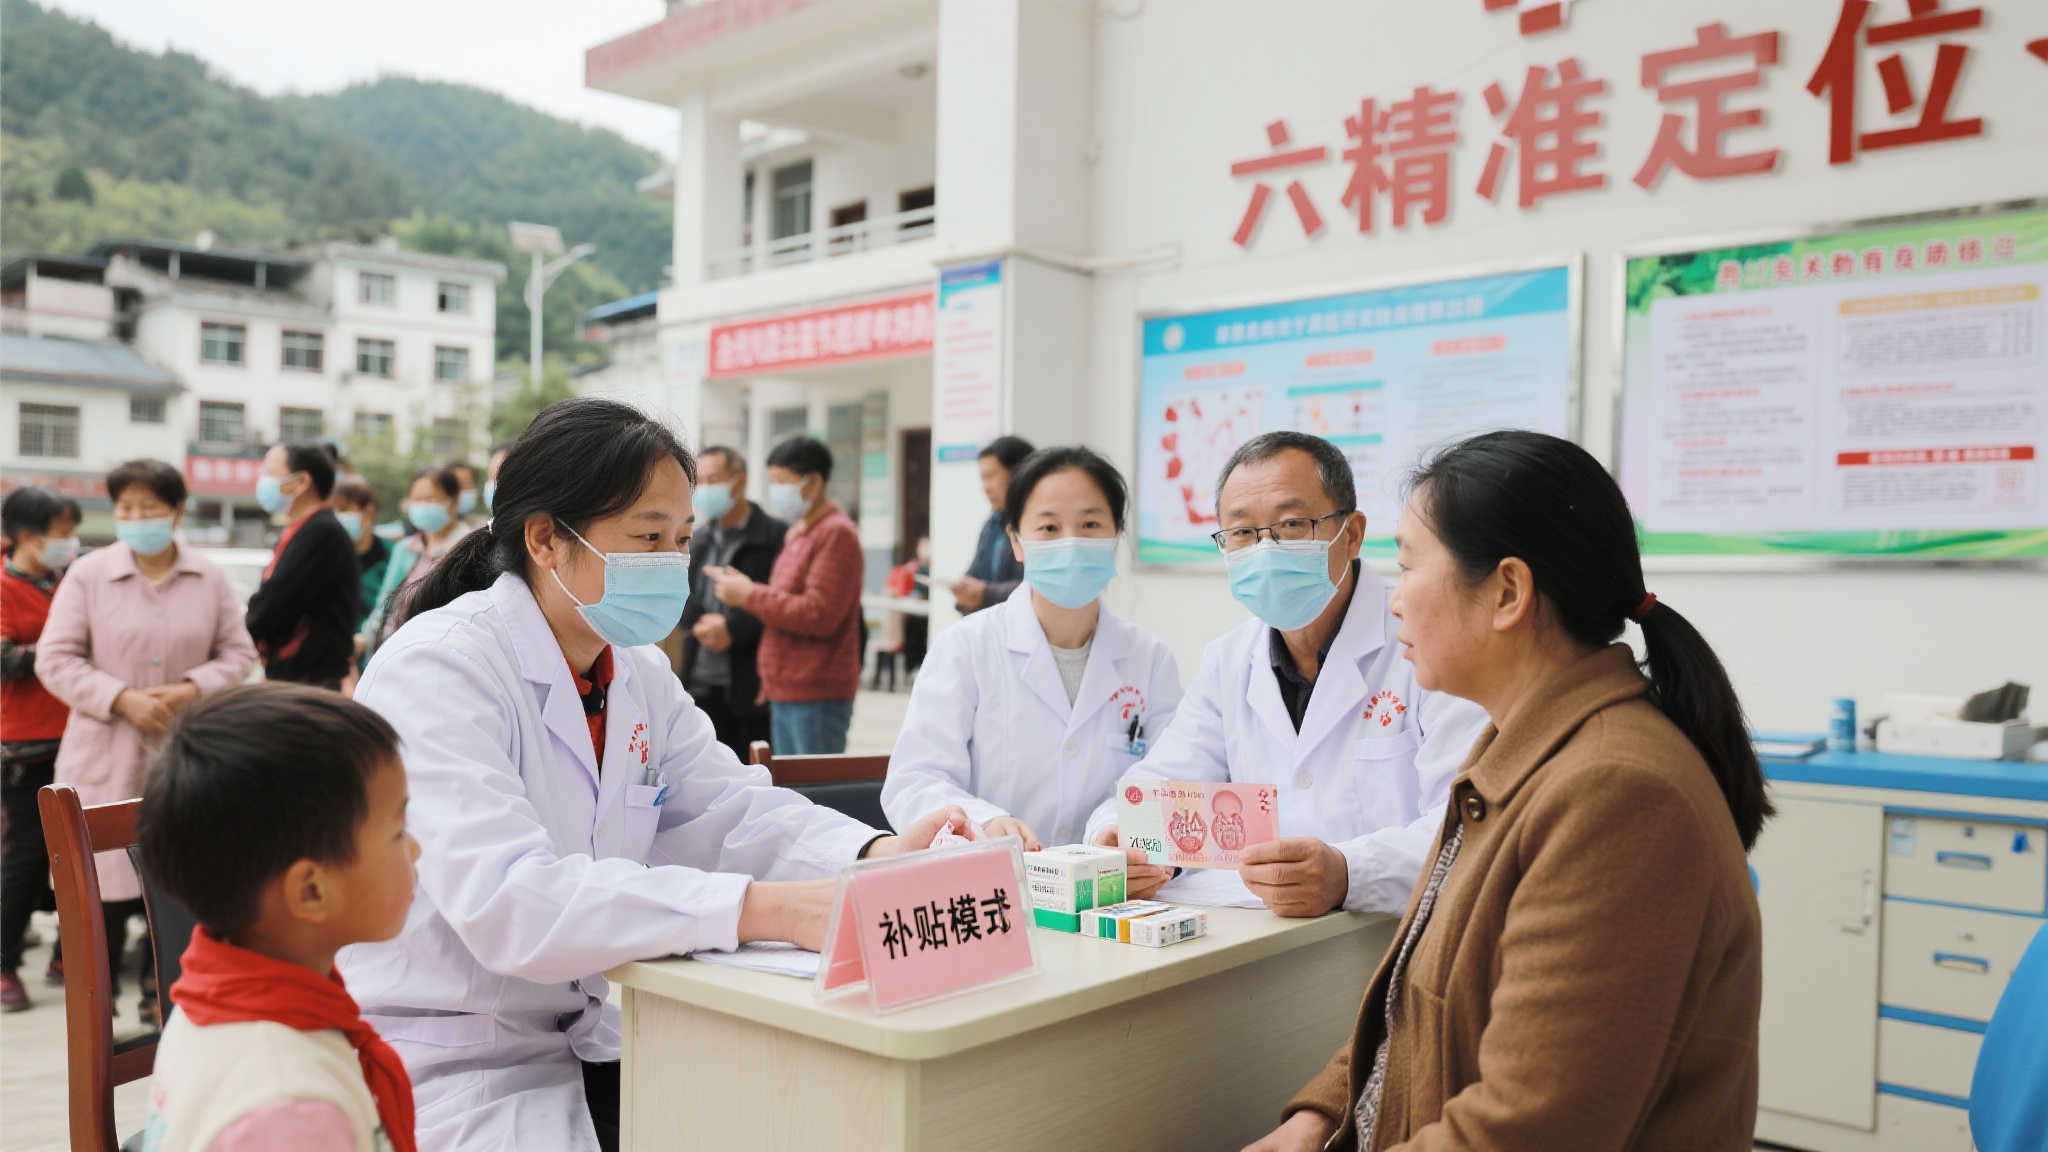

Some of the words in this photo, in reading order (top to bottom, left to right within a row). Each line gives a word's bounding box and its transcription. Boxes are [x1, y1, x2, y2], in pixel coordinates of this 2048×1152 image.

[1230, 0, 2048, 248] 六精准定位
[878, 887, 1012, 960] 补贴模式
